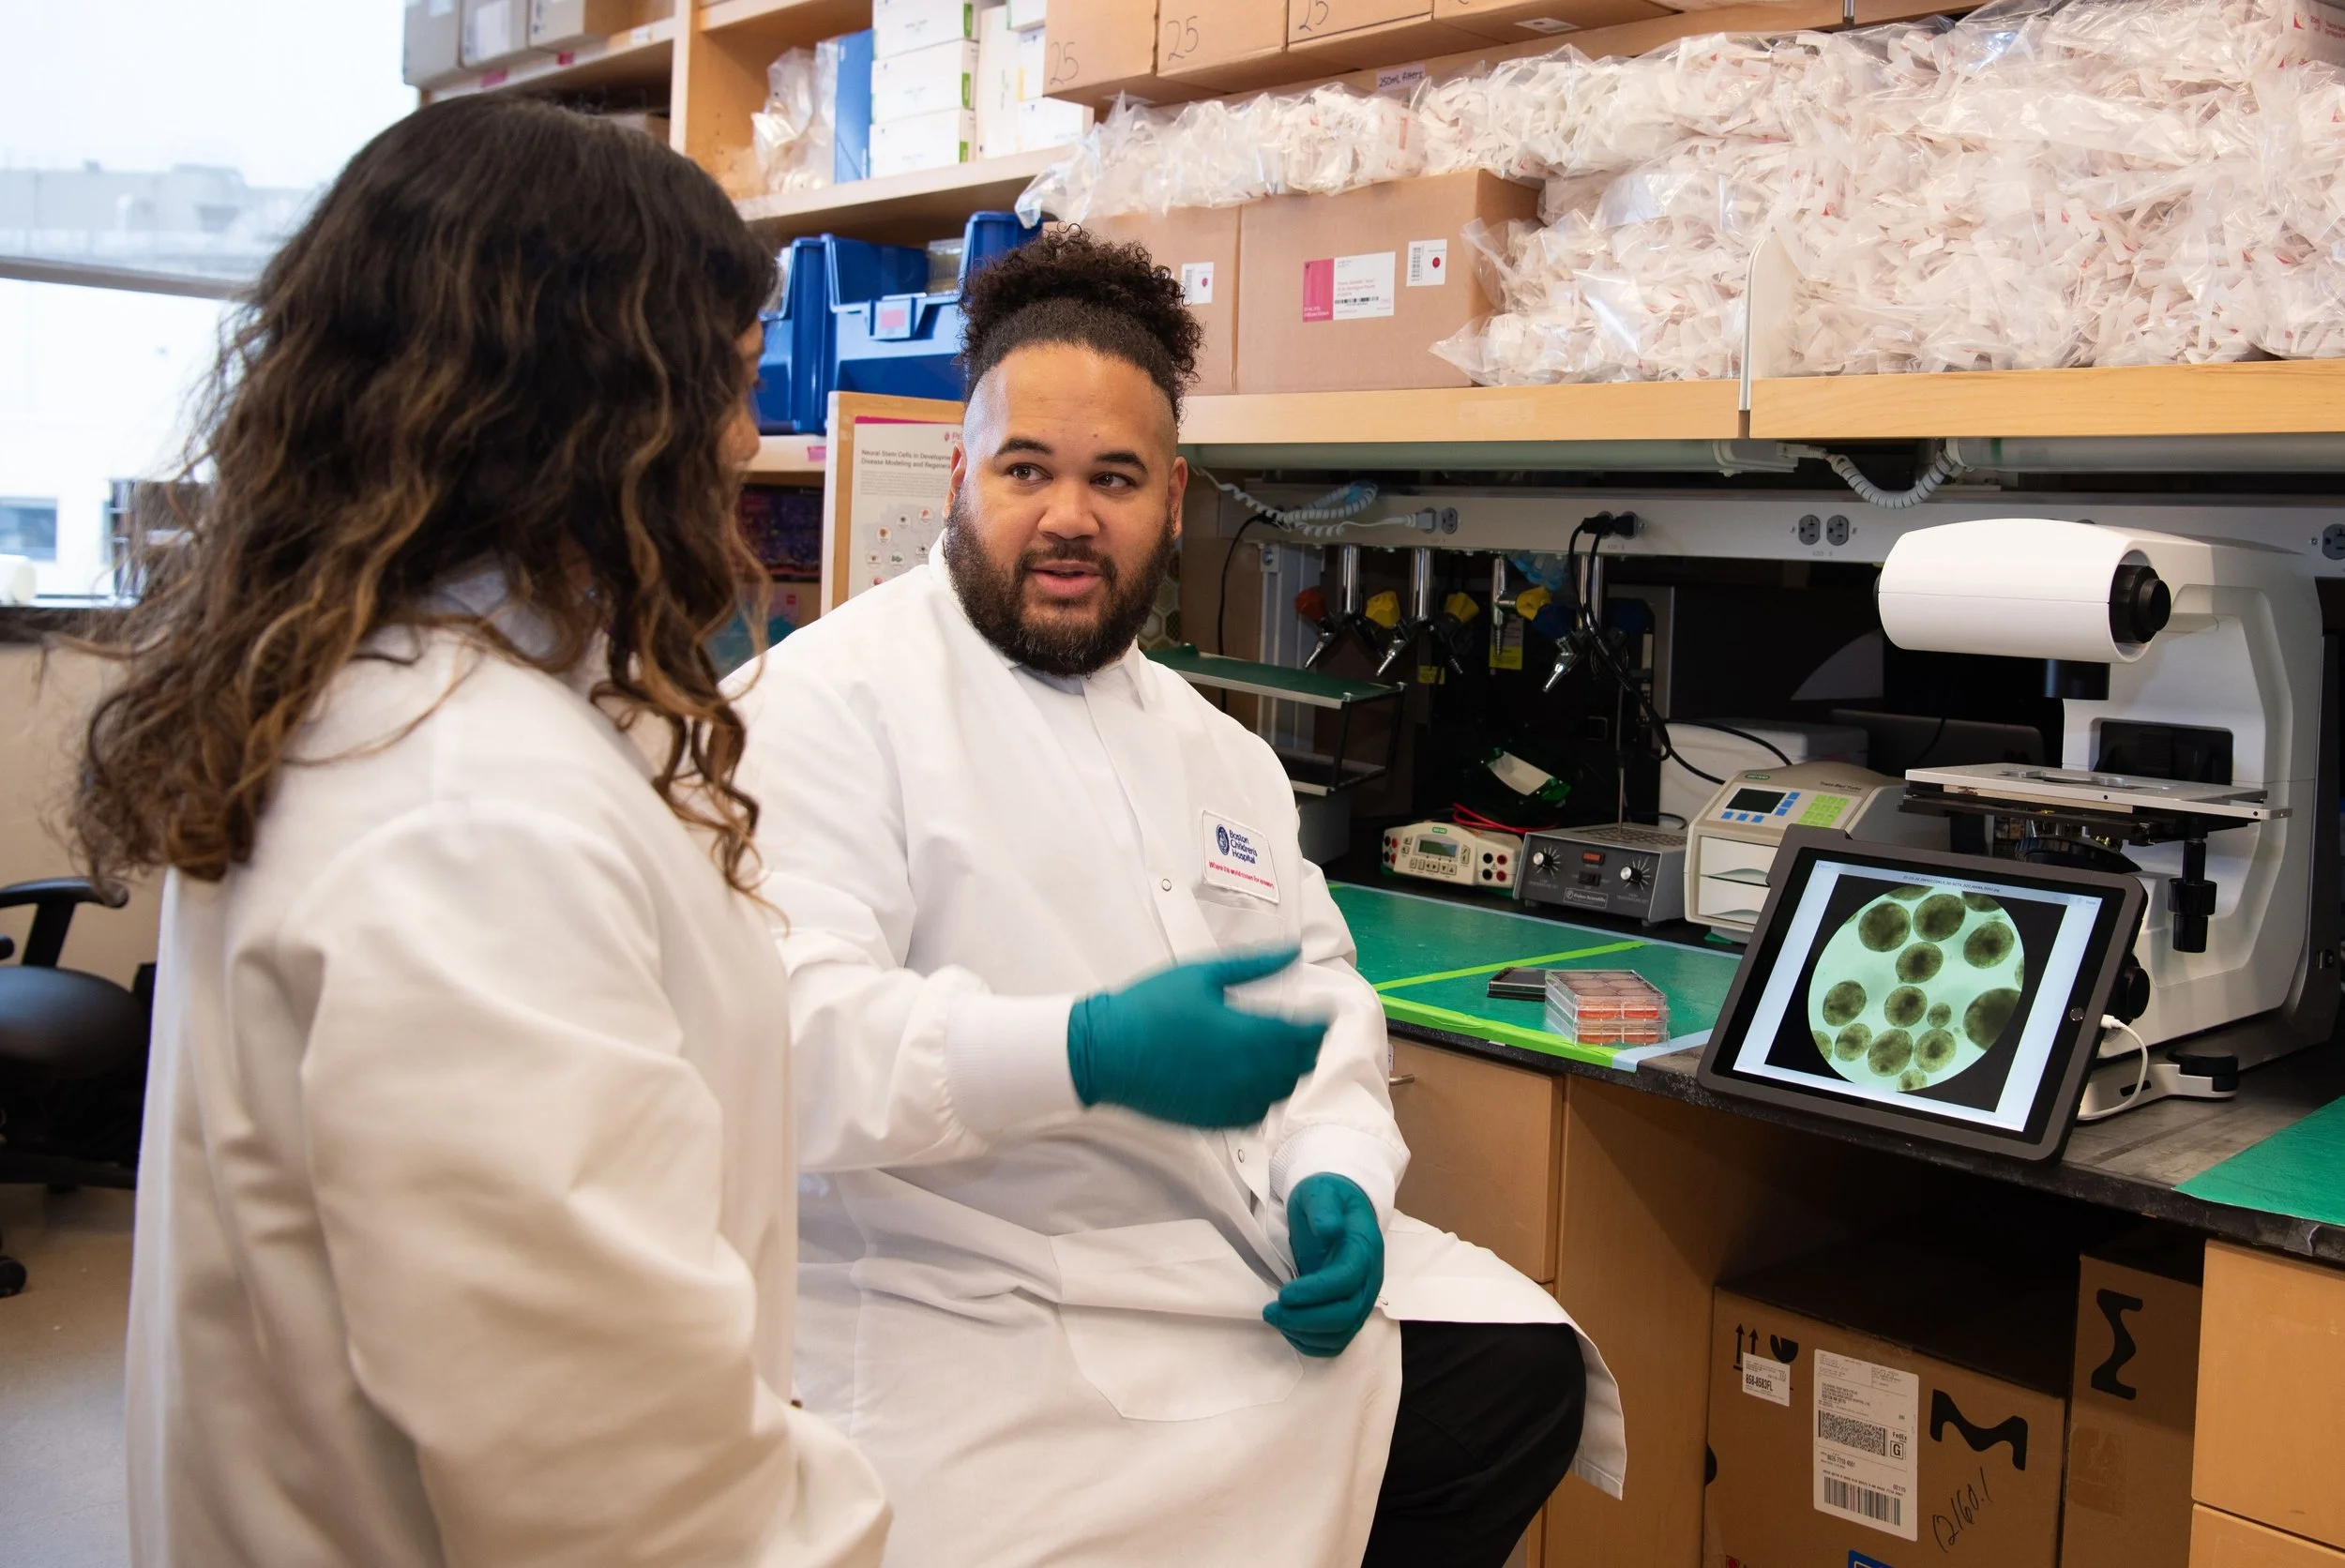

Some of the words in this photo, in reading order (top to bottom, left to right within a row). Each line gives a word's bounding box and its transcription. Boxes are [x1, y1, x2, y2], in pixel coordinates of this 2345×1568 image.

[1165, 15, 1200, 61] 25
[1049, 41, 1080, 85] 25
[898, 450, 912, 459] Cells
[885, 460, 911, 468] Modeling
[1229, 829, 1248, 844] Boston
[1232, 849, 1256, 864] Hospital
[1892, 1431, 1907, 1440] FedEx
[1893, 1443, 1901, 1456] G
